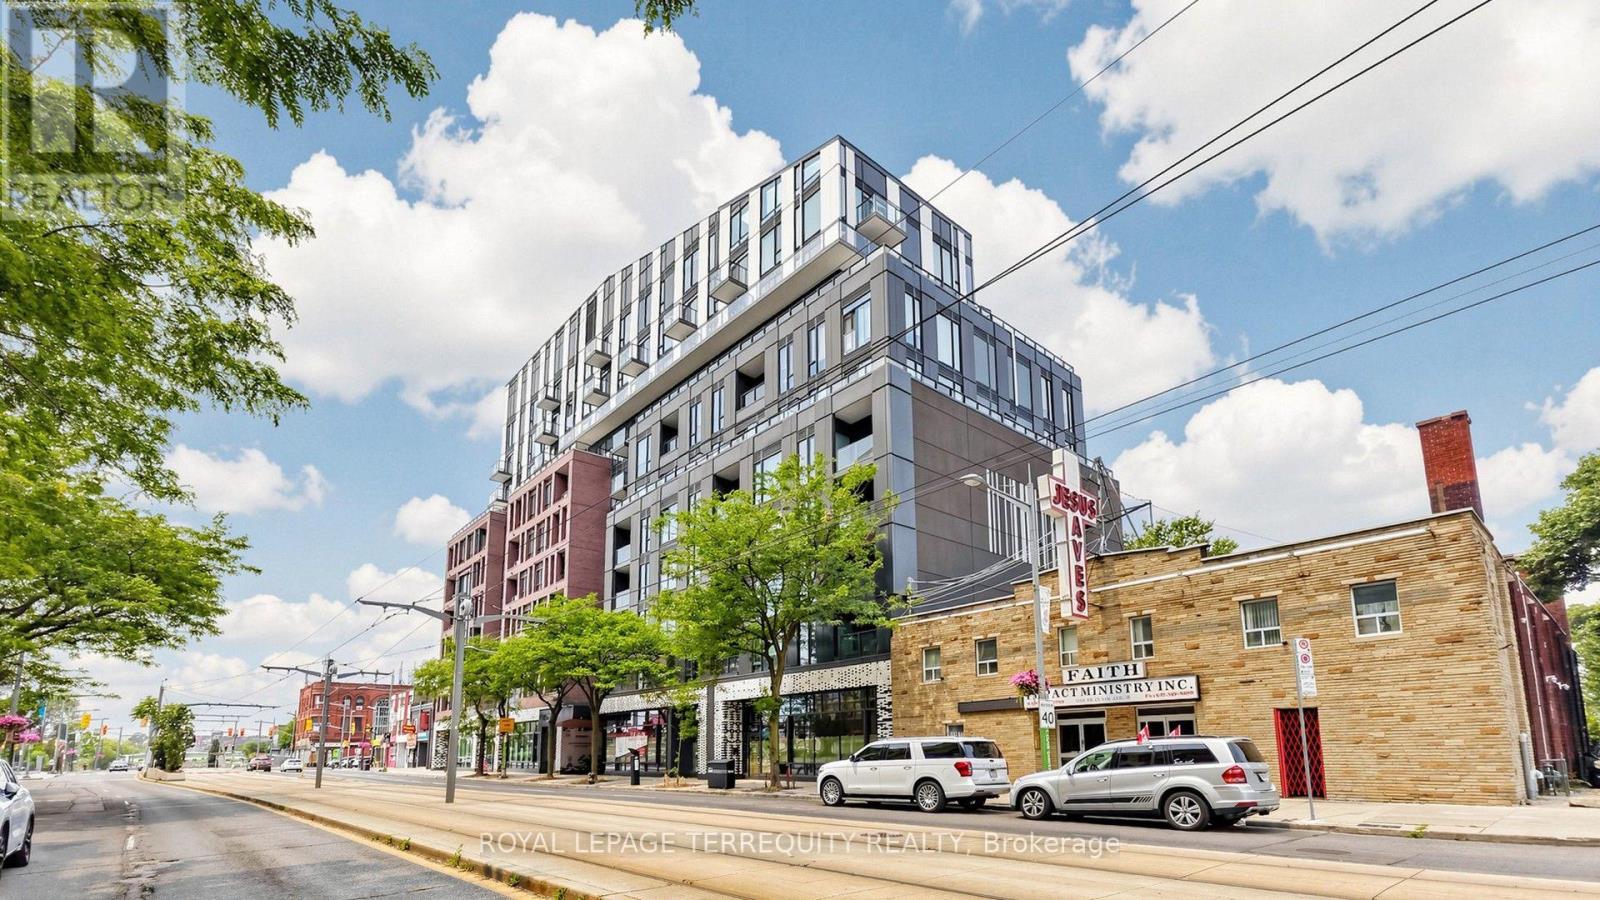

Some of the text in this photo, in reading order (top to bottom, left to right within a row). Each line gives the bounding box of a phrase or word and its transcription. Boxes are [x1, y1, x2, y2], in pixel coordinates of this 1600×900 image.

[1053, 484, 1097, 519] JESUS
[1067, 664, 1140, 681] FAITH
[1081, 682, 1153, 697] MINISTRY
[1158, 679, 1194, 691] INC.
[1042, 711, 1054, 724] 40
